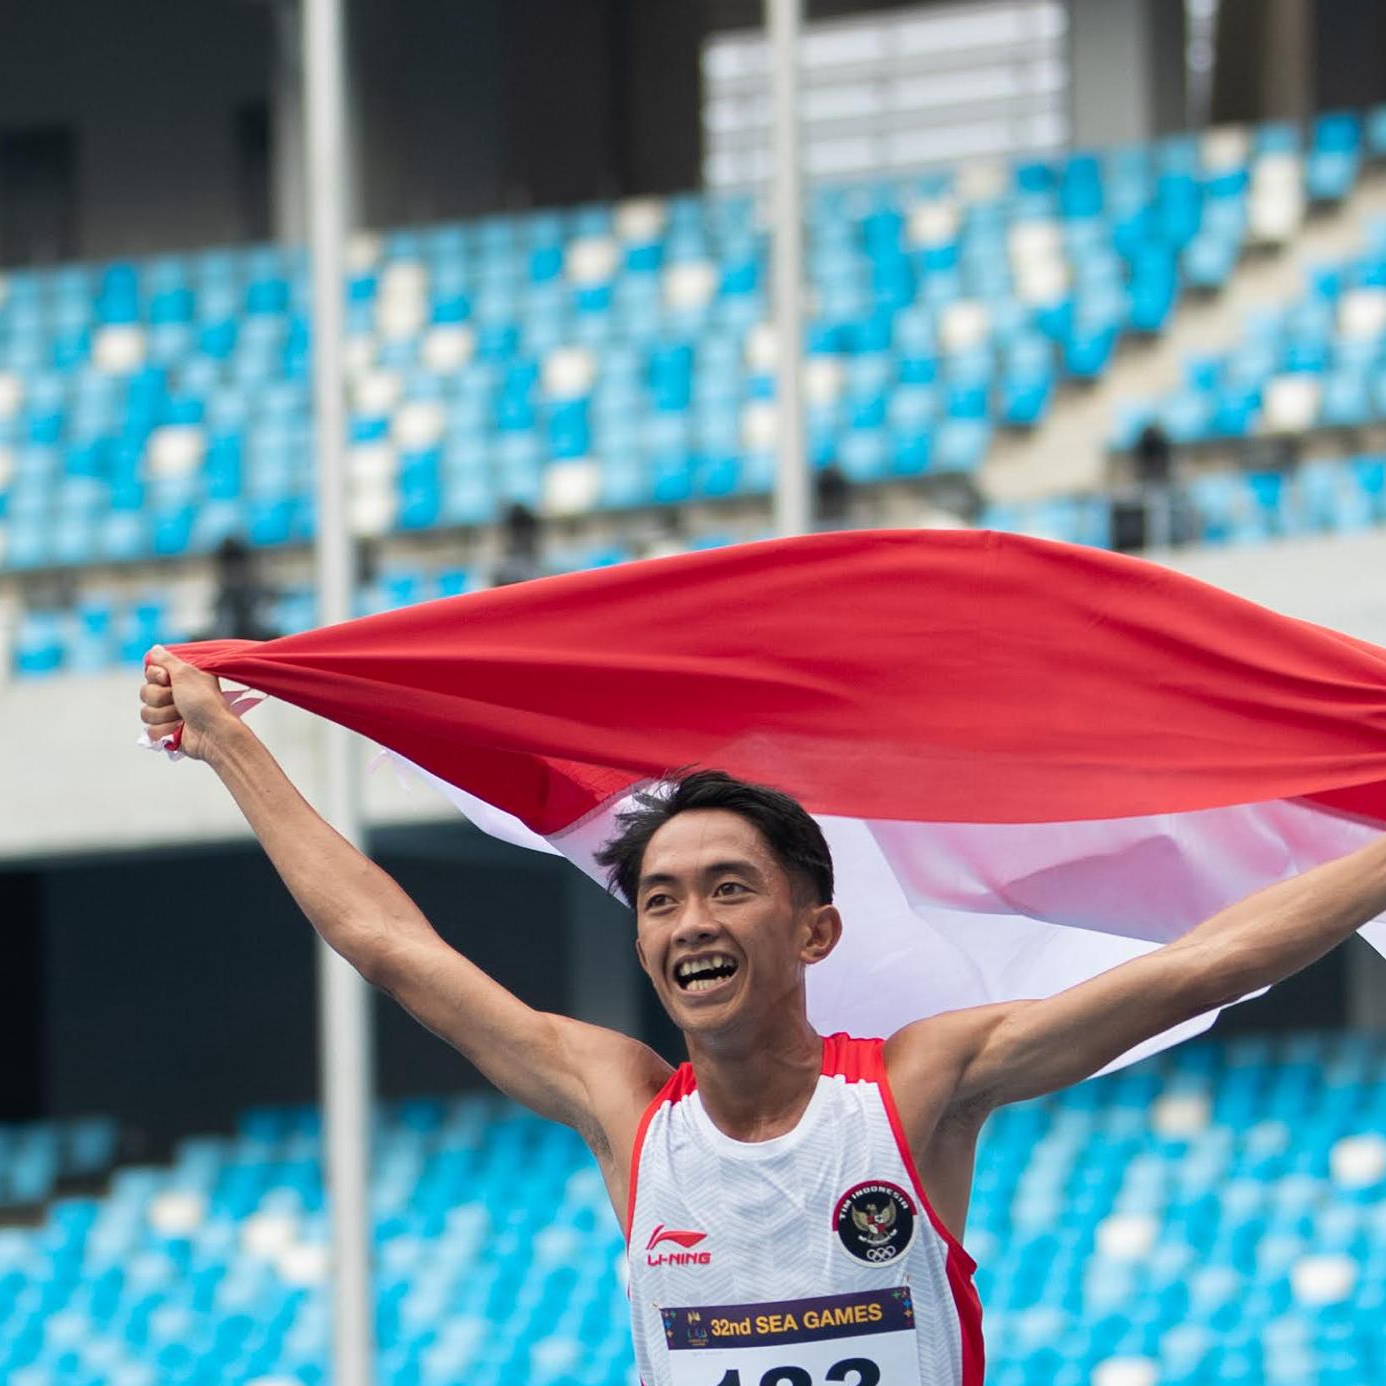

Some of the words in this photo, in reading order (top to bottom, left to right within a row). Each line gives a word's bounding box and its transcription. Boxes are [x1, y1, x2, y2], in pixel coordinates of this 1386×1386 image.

[838, 1199, 853, 1221] TIM
[851, 1185, 910, 1210] INDONESIA
[647, 1251, 712, 1267] LI-NING
[710, 1317, 752, 1338] 32nd
[756, 1314, 799, 1335] SEA
[803, 1303, 883, 1329] GAMES
